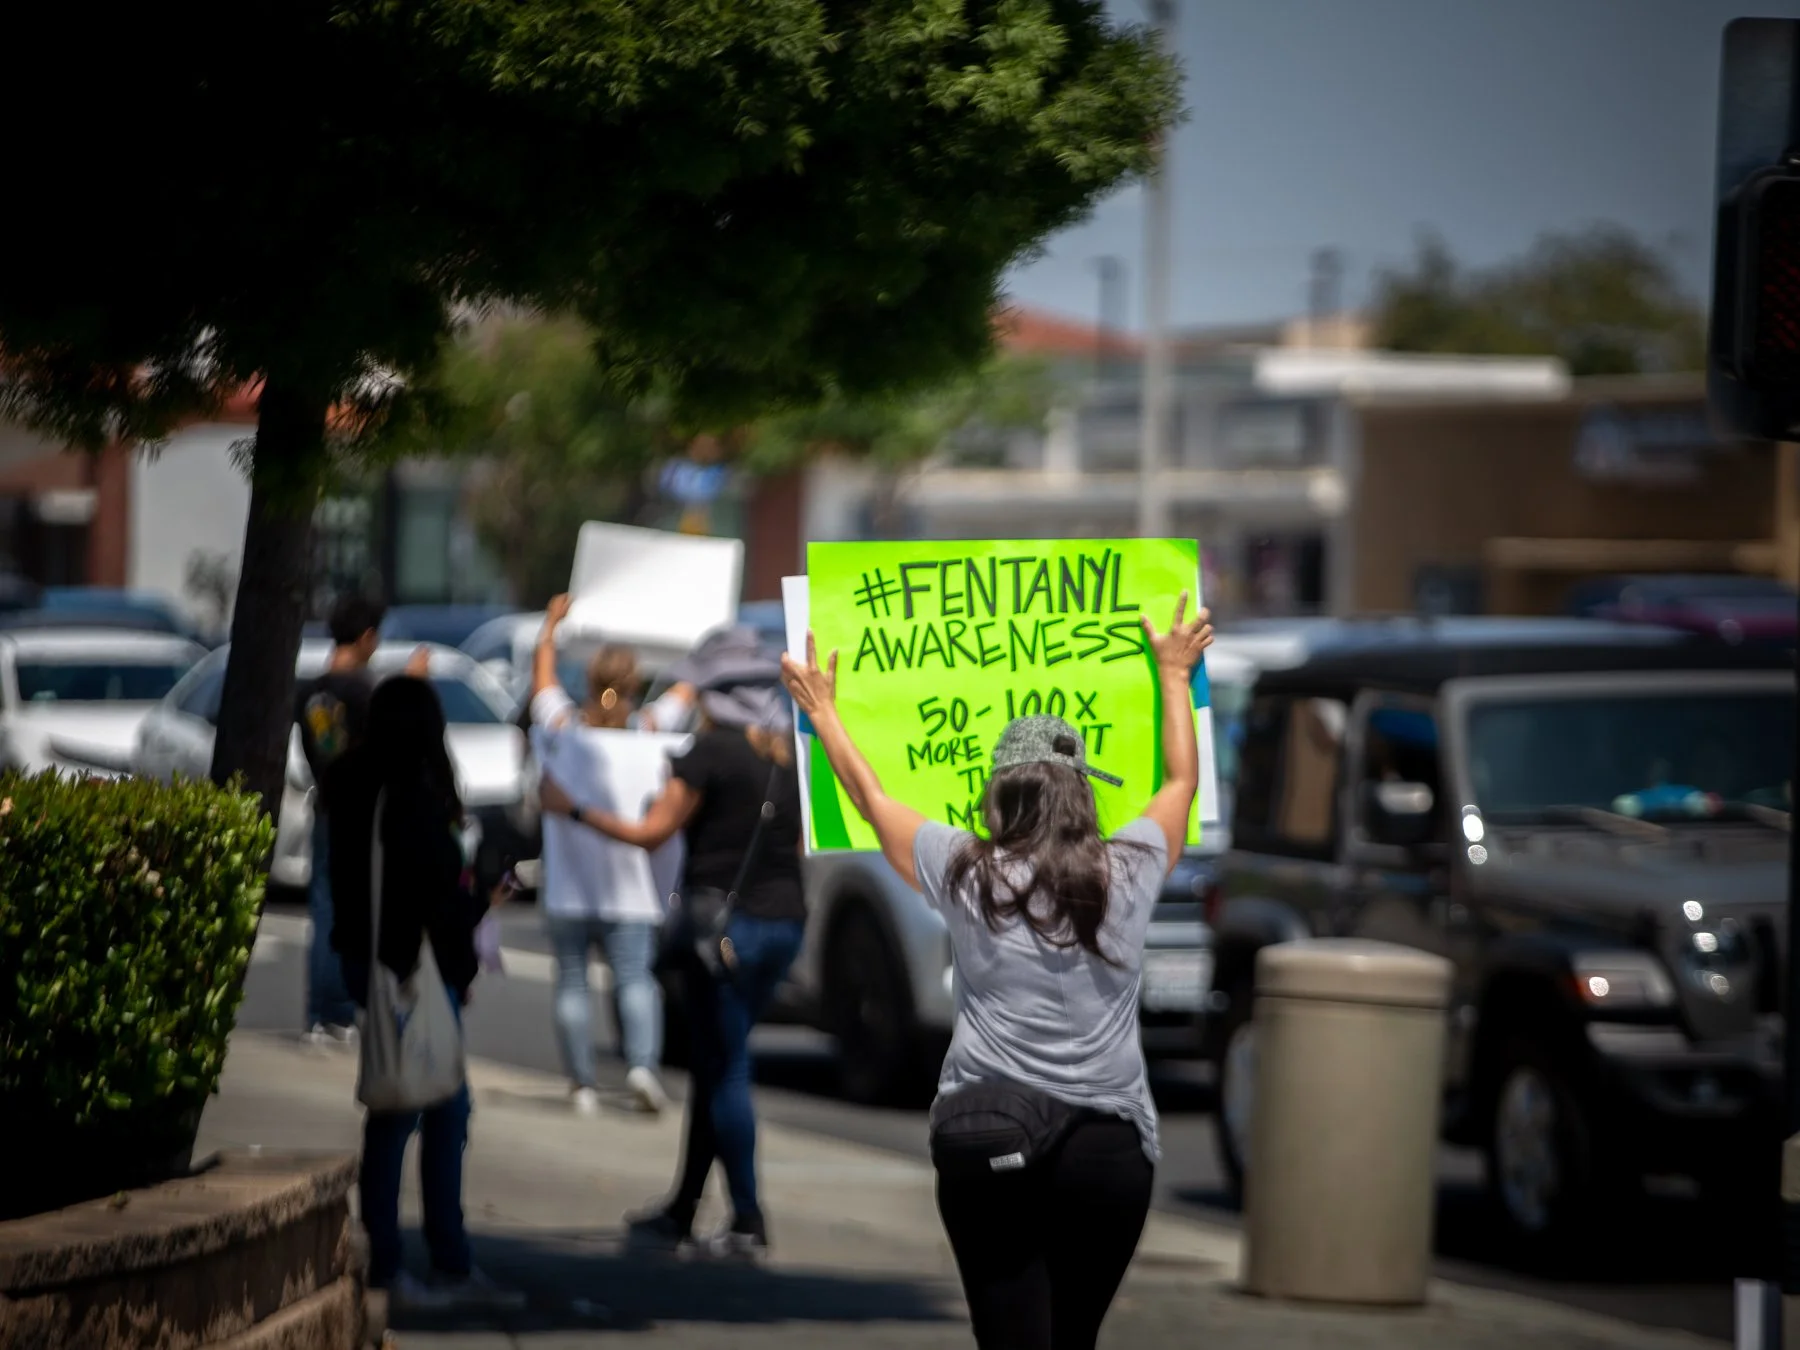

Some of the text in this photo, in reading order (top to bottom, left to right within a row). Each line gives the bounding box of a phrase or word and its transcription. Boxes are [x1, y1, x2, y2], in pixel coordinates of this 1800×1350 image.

[854, 548, 1140, 620] #FENTANYL
[853, 618, 1145, 672] AWARENESS
[907, 735, 984, 771] MORE
